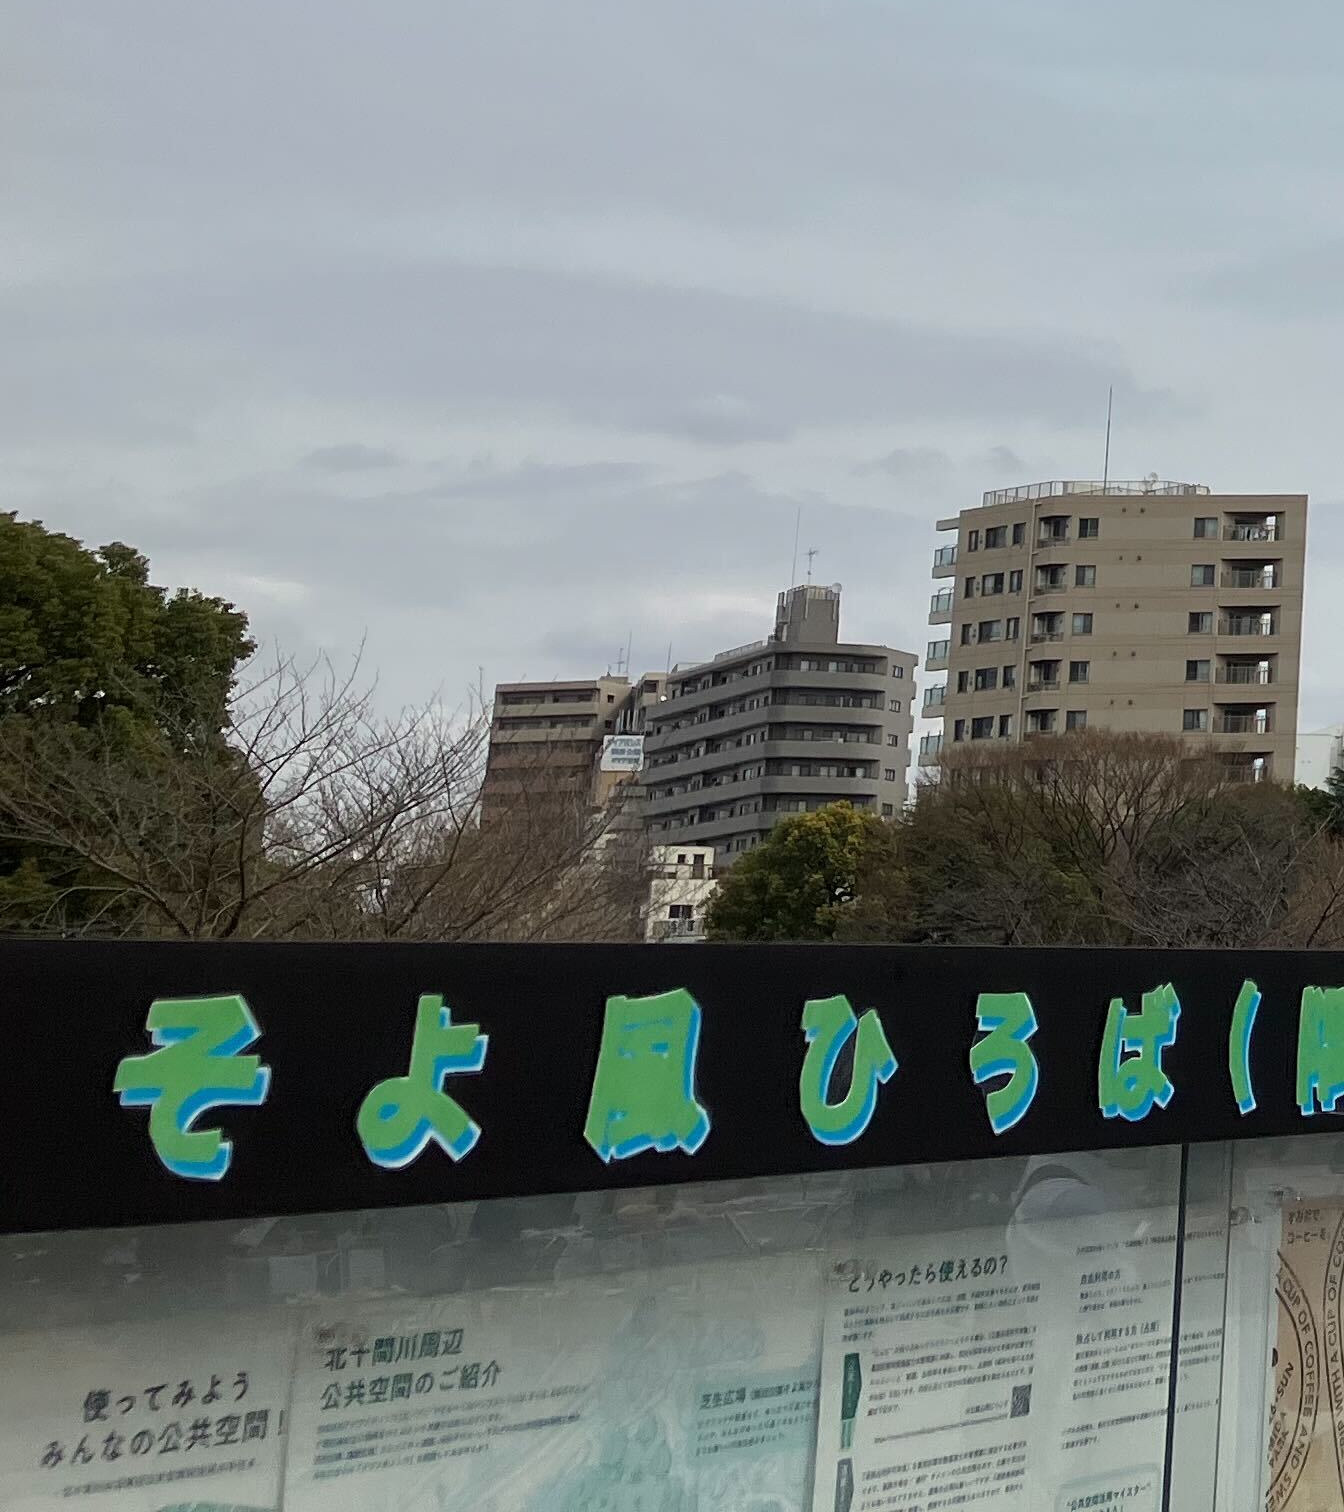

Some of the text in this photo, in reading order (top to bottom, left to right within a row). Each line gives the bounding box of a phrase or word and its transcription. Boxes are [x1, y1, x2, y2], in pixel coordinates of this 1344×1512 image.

[324, 1327, 465, 1372] 北十間川周辺
[1327, 1309, 1337, 1347] CUP
[82, 1370, 251, 1424] 使ってみよう
[320, 1359, 504, 1411] 公共空間のご紹介
[1303, 1340, 1315, 1418] COFFEE
[1331, 1368, 1344, 1418] WITH
